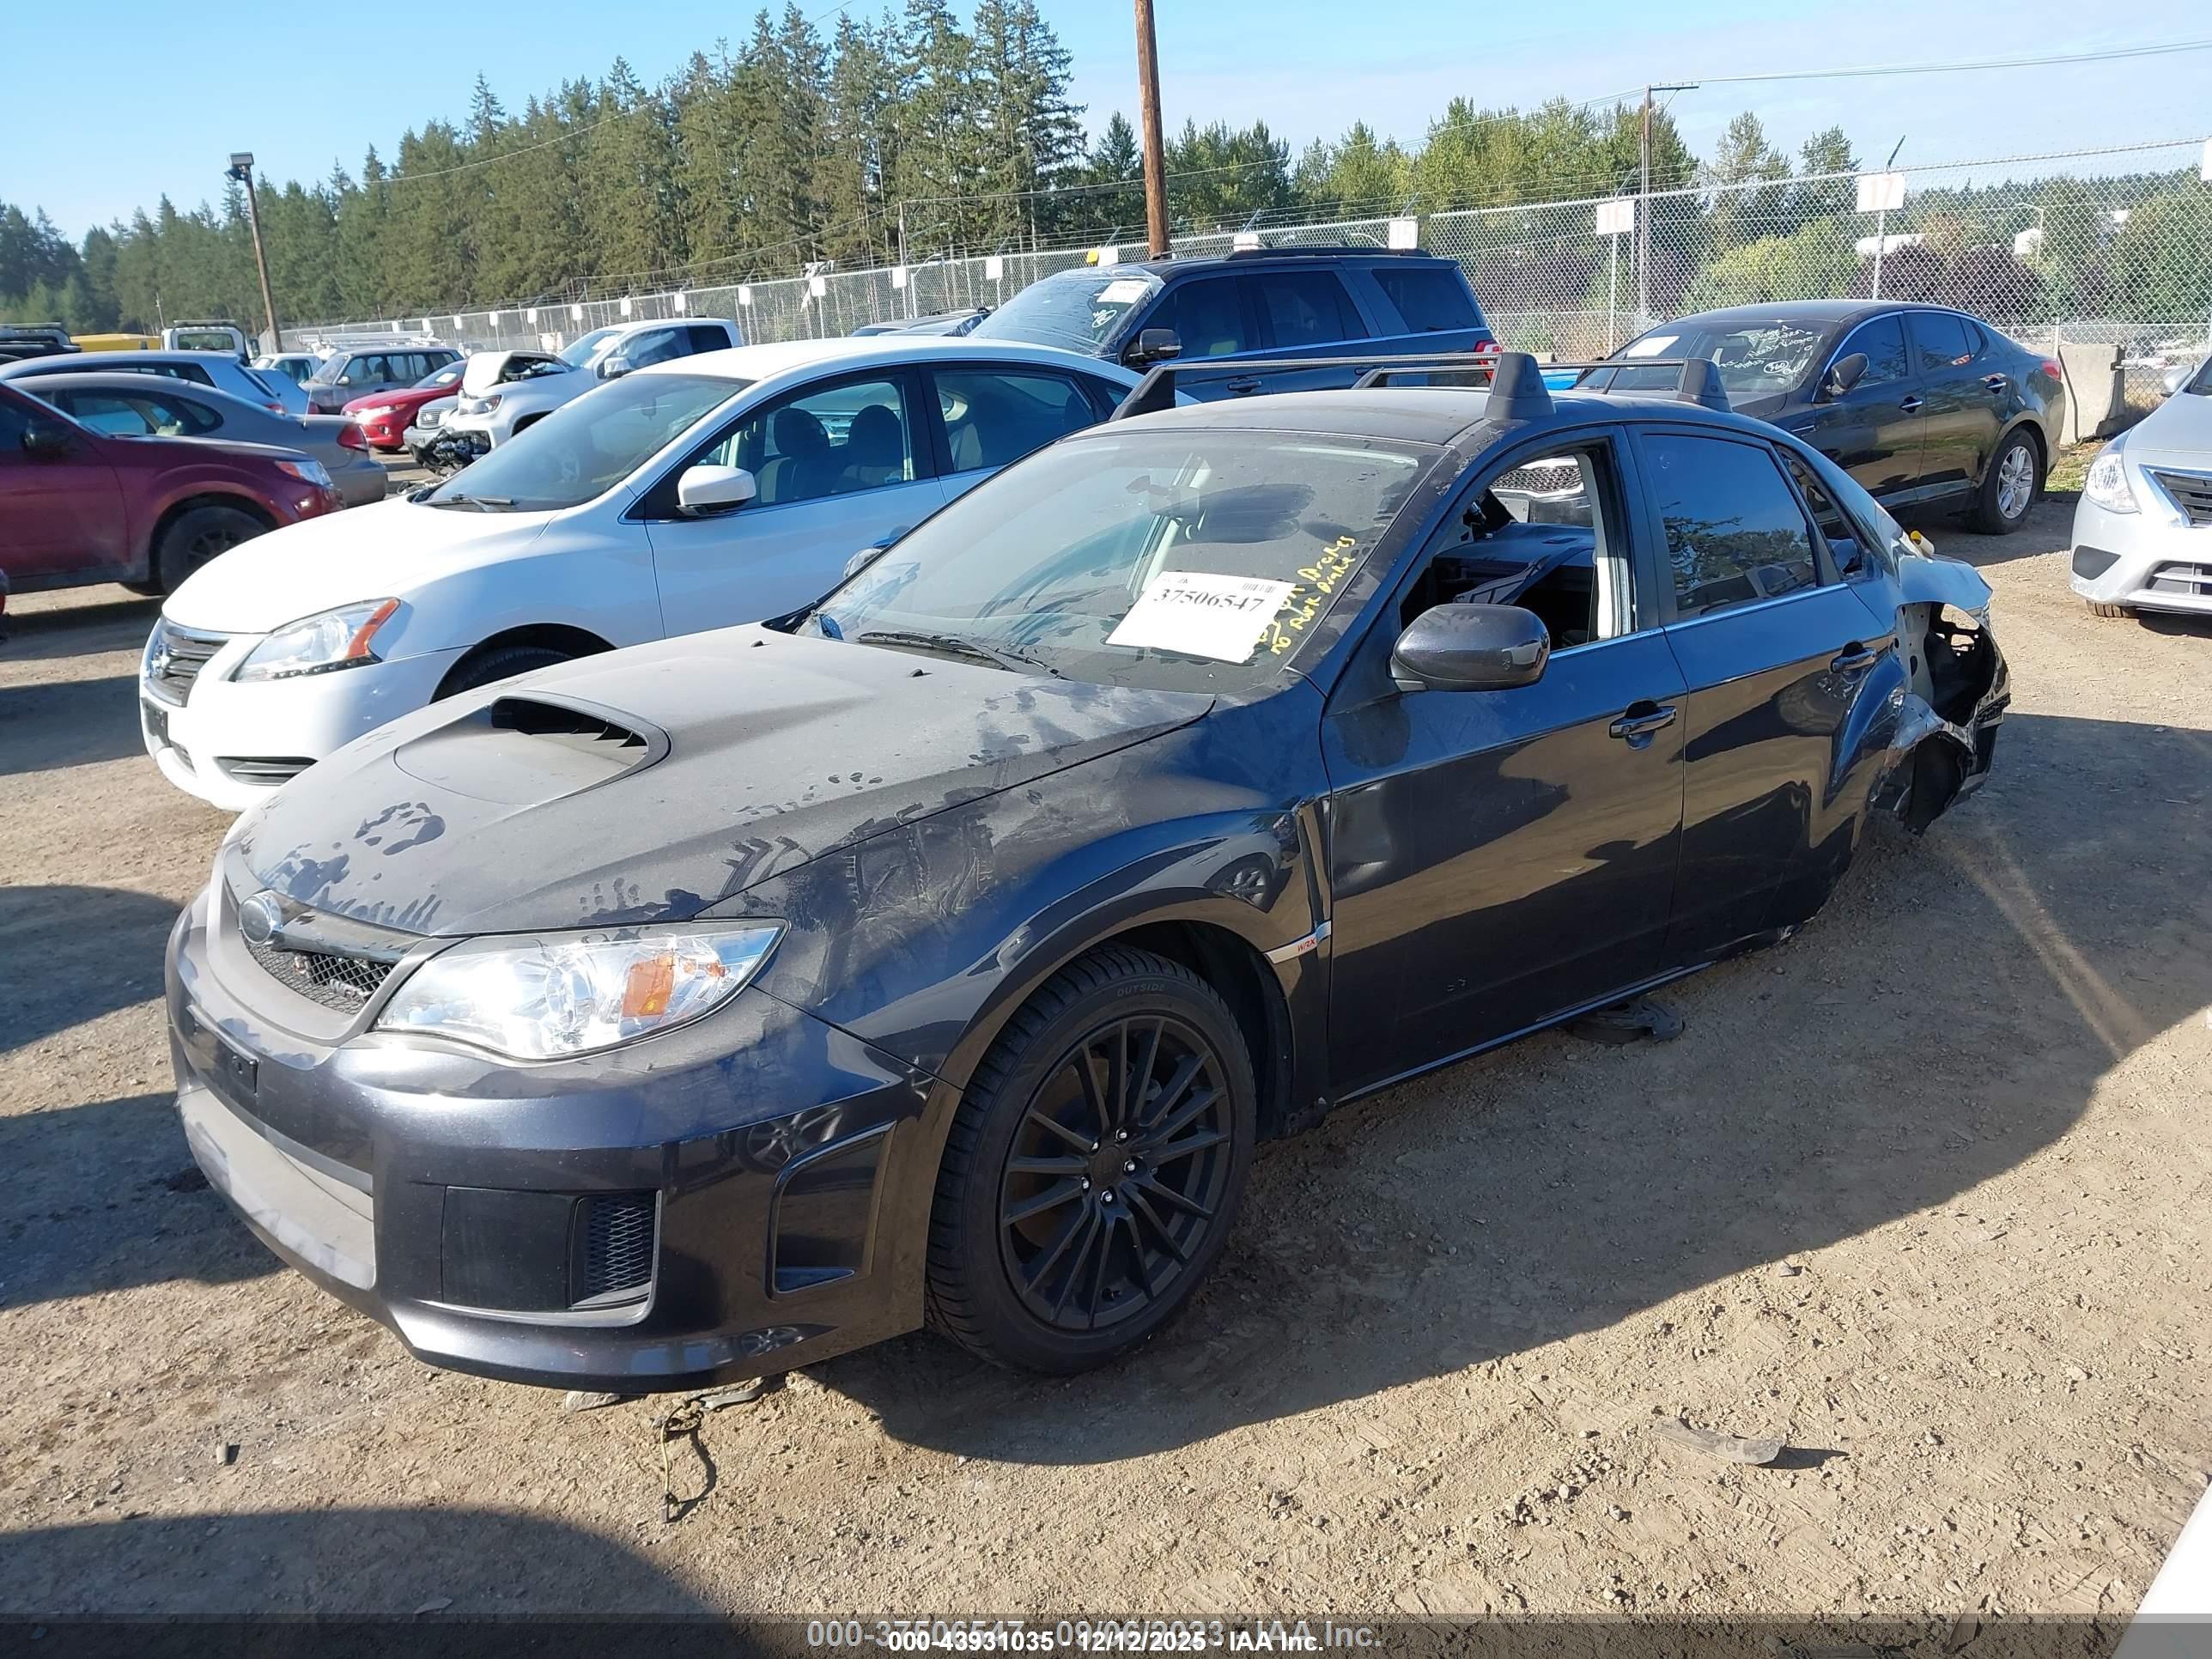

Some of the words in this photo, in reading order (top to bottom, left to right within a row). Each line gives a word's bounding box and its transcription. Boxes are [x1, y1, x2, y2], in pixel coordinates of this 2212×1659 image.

[1870, 177, 1896, 207] 17
[1605, 205, 1627, 230] 16
[1153, 588, 1265, 612] 37506547
[1297, 938, 1316, 952] WRX
[1116, 982, 1166, 997] OUTSIDE
